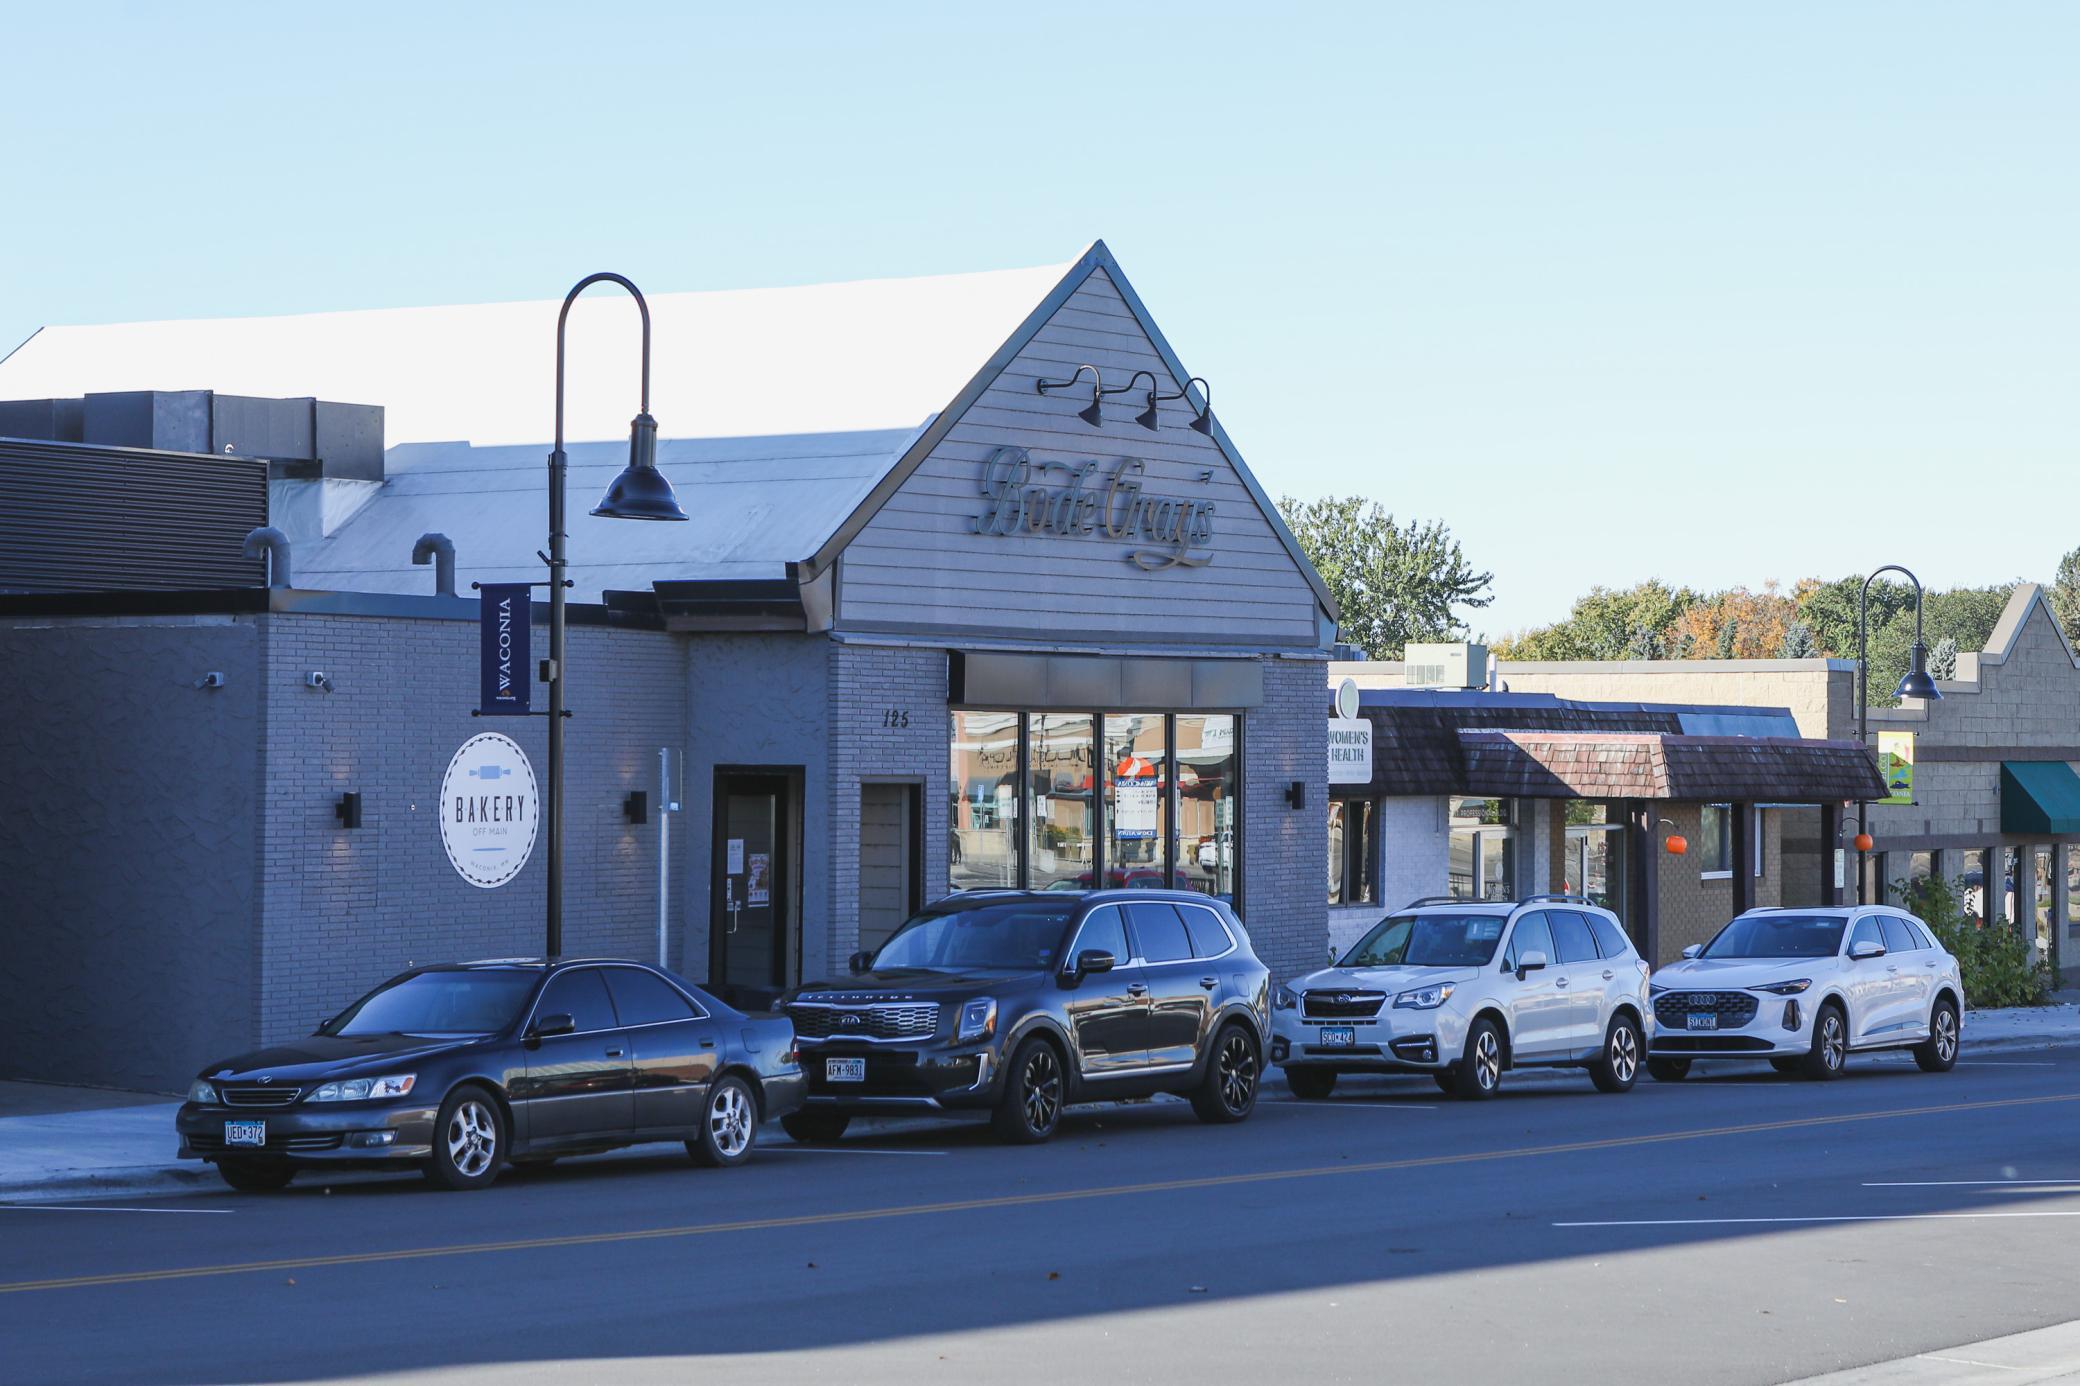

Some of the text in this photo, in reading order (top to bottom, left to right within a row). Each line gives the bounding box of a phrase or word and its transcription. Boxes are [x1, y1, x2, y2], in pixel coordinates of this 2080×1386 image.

[499, 598, 511, 690] WACONIA
[883, 709, 909, 728] 125
[1328, 730, 1369, 745] WOMEN'S
[1331, 747, 1365, 761] HEALTH
[456, 795, 524, 823] BAKERY
[472, 827, 508, 837] OFF MAIN
